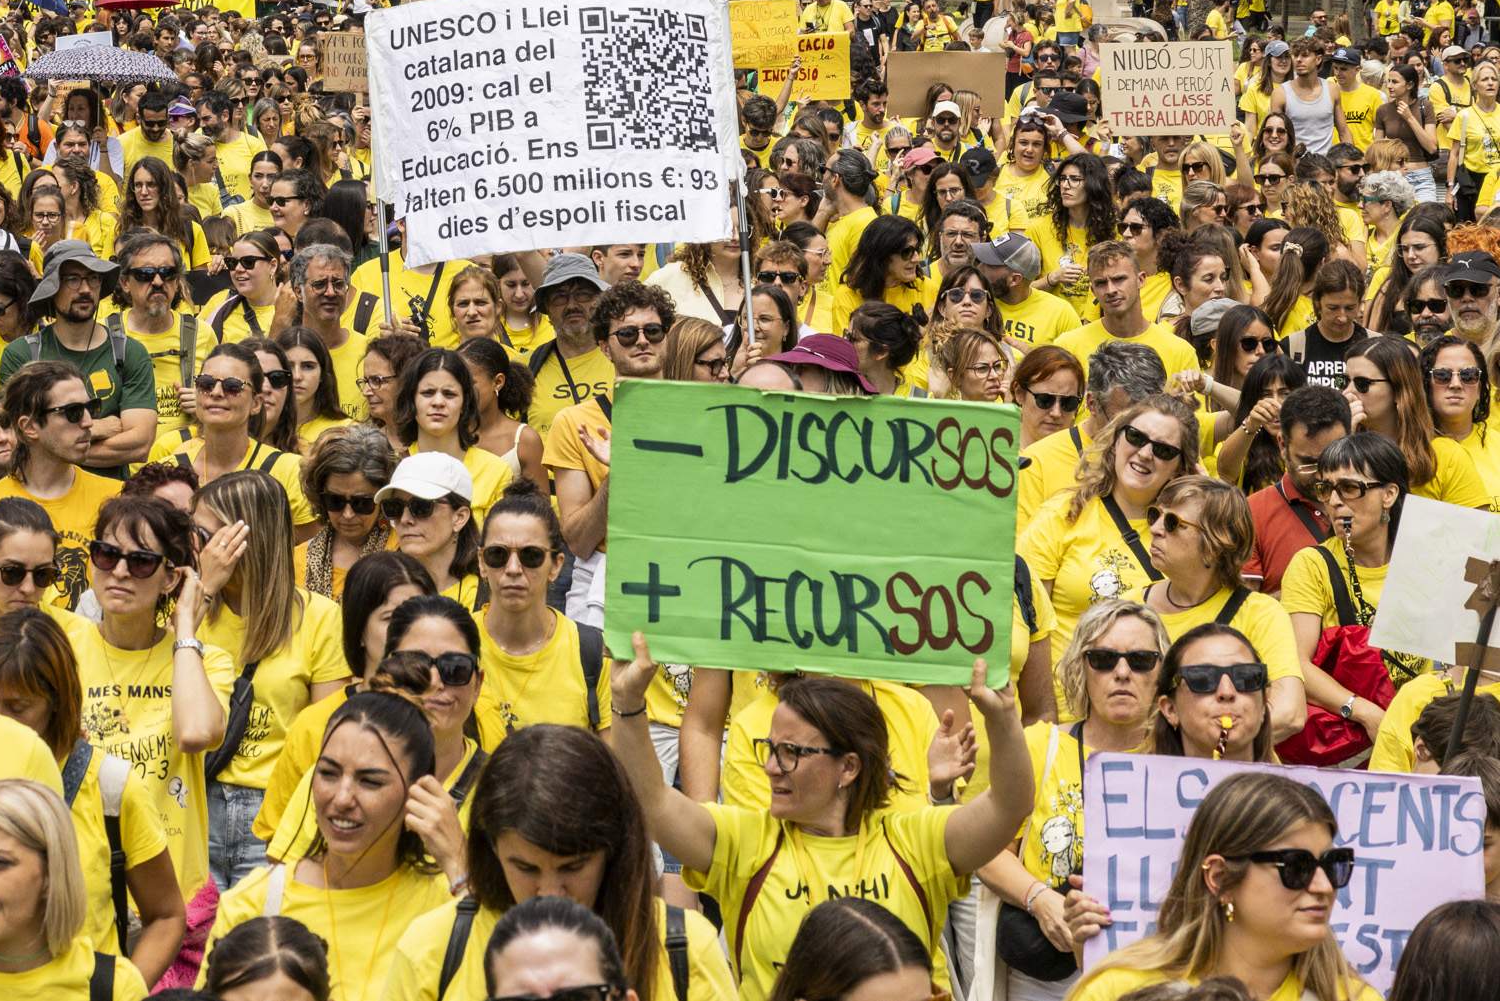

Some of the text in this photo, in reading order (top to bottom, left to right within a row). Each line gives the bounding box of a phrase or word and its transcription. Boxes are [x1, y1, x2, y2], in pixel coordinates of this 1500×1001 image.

[390, 4, 570, 50] UNESCO i Llei
[404, 38, 556, 81] catalana del
[1179, 47, 1225, 70] SURT
[411, 71, 552, 113] 2009: cal el
[1118, 77, 1169, 91] DEMANA
[1177, 72, 1214, 92] PERDÓ
[1221, 77, 1231, 92] A
[1131, 94, 1213, 108] LA CLASSE
[427, 108, 539, 143] 6% PIB a
[1111, 110, 1226, 128] TREBALLADORA
[402, 138, 580, 182] Educació. Ens
[405, 166, 720, 214] falten 6.500 milions €: 93
[438, 199, 687, 240] dies d'espoli fiscal
[553, 381, 609, 401] SOS
[706, 396, 1014, 498] DISCURSOS
[687, 555, 995, 656] RECURSOS
[127, 685, 173, 698] MANS
